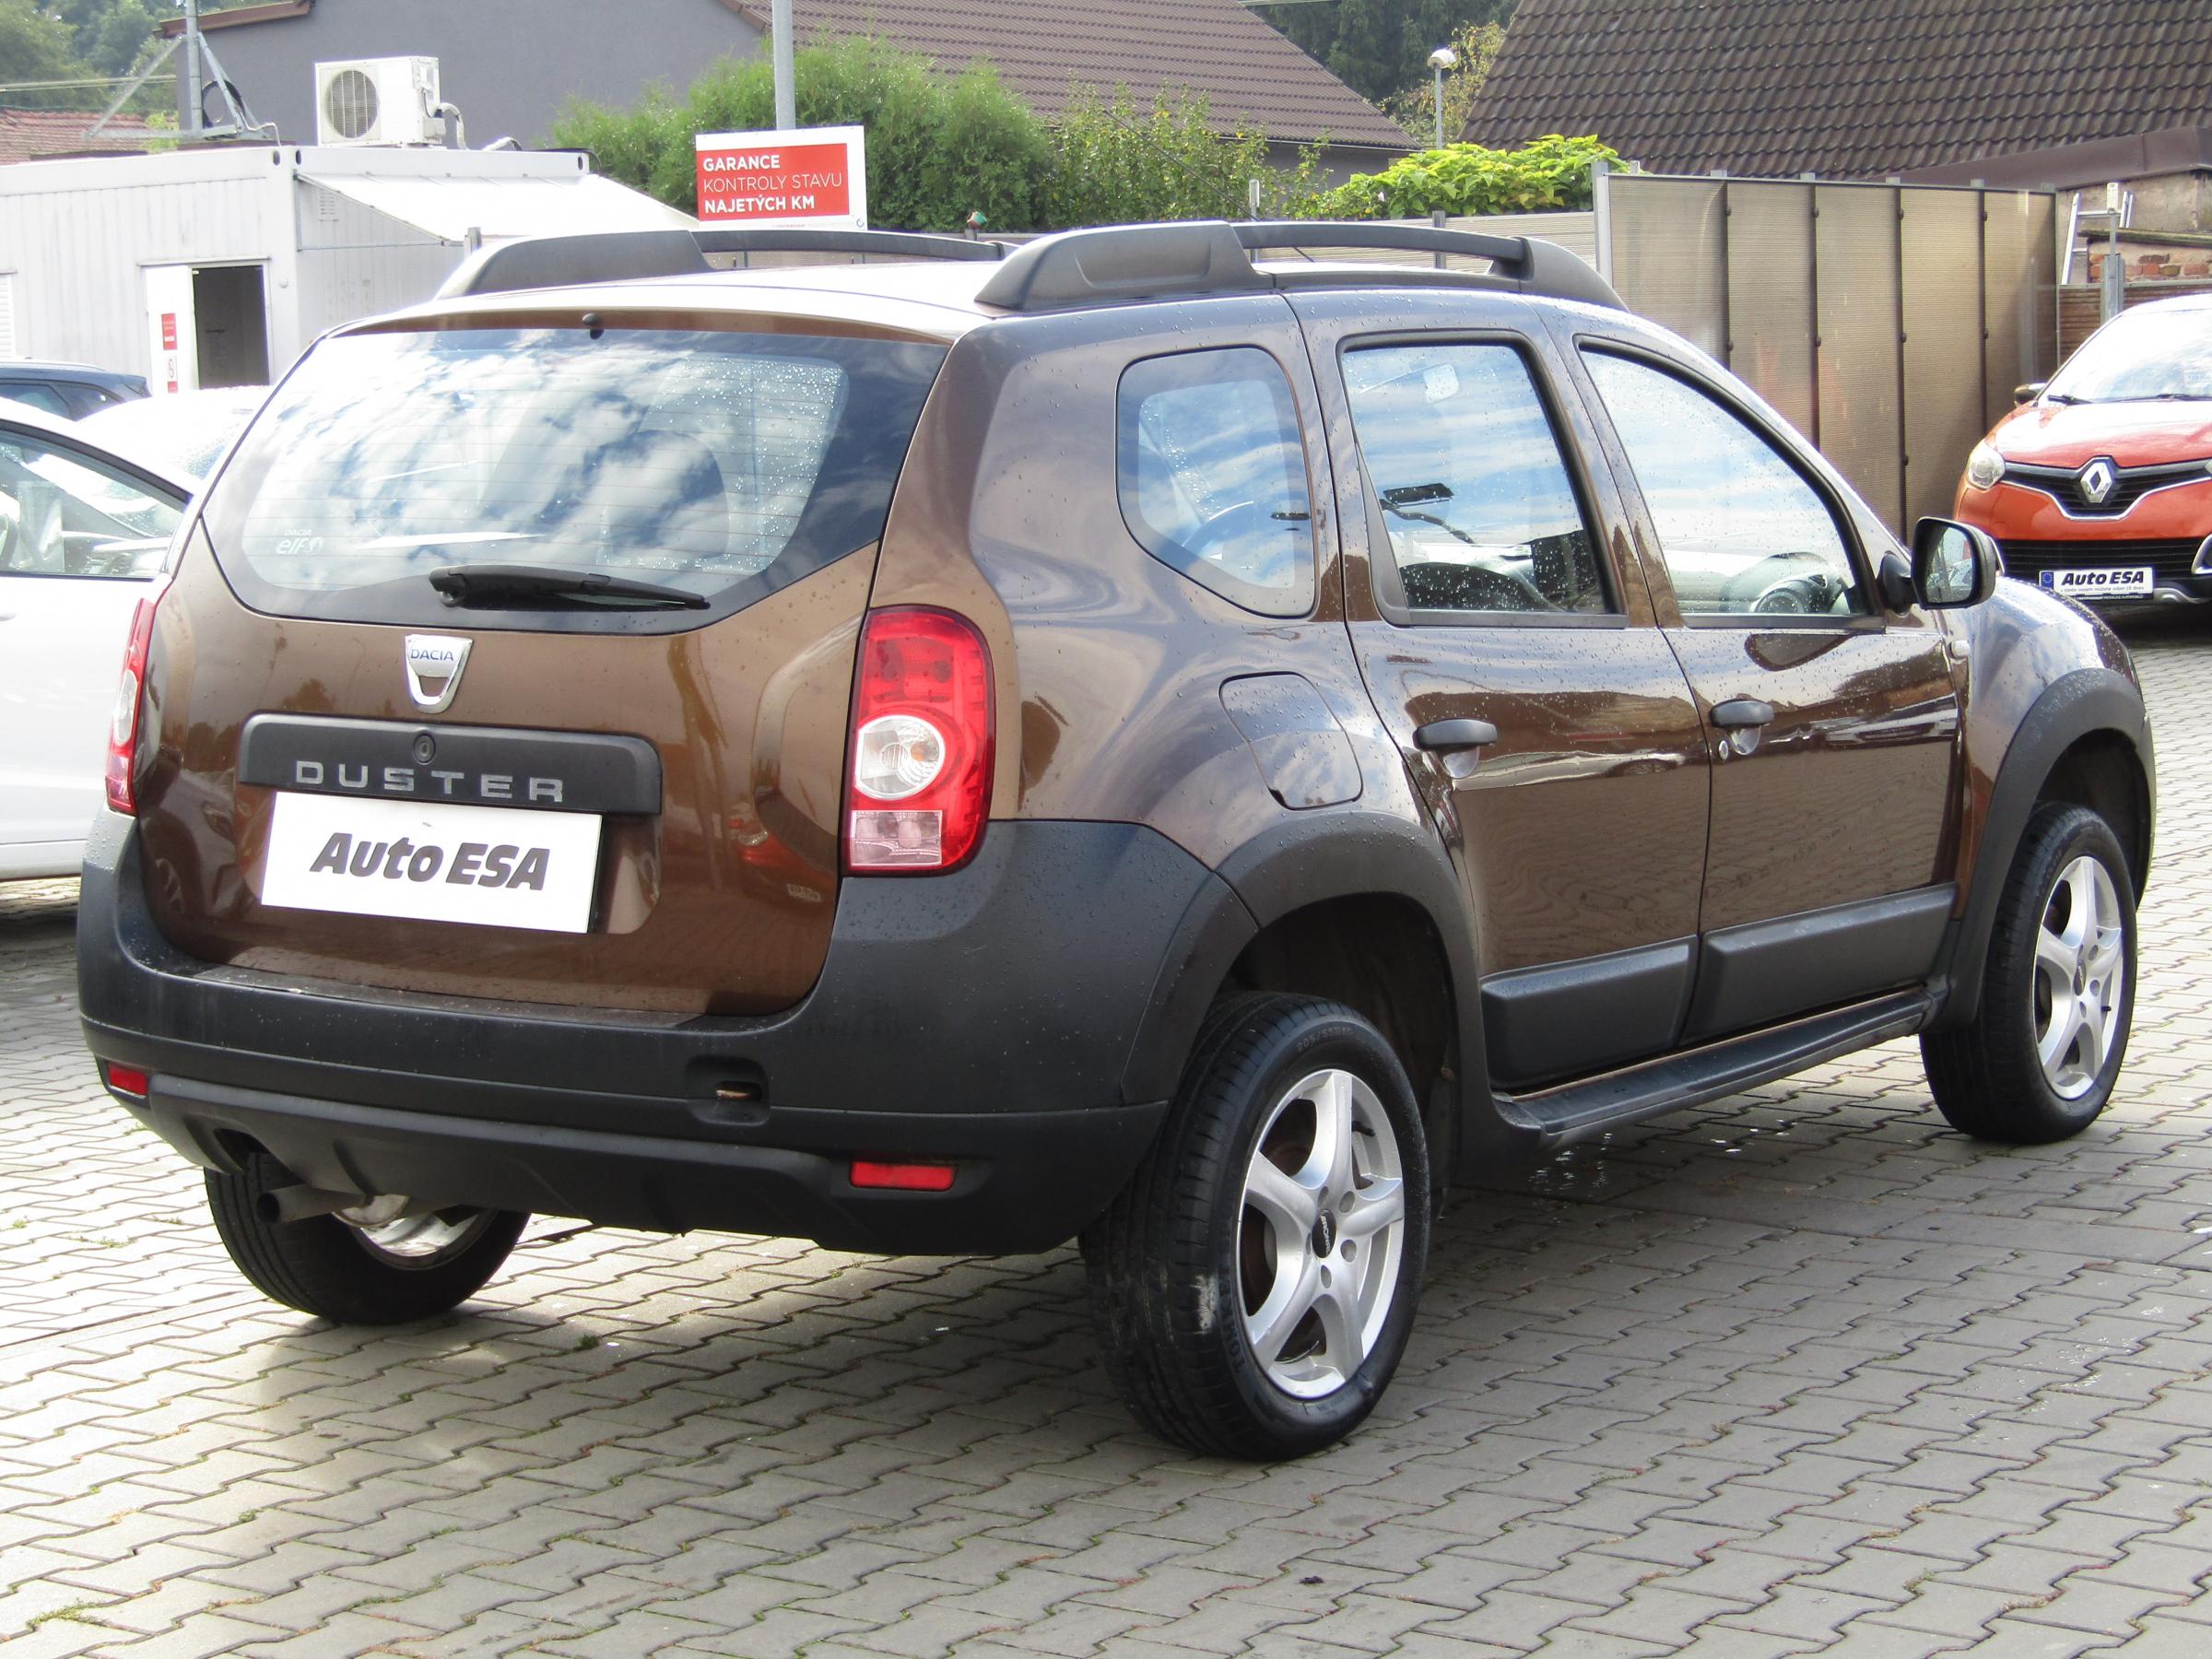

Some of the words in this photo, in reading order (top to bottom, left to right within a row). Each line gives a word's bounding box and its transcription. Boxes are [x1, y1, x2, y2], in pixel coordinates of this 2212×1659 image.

[703, 155, 781, 171] GARANCE
[703, 175, 787, 193] KONTROLY
[792, 172, 842, 189] STAVU
[704, 194, 786, 214] NAJETÝCH
[791, 195, 815, 210] KM
[2061, 572, 2107, 586] Auto
[2109, 571, 2144, 584] ESA
[410, 649, 454, 661] DACIA
[295, 759, 563, 803] DUSTER
[310, 832, 444, 883] Auto
[445, 842, 550, 890] ESA
